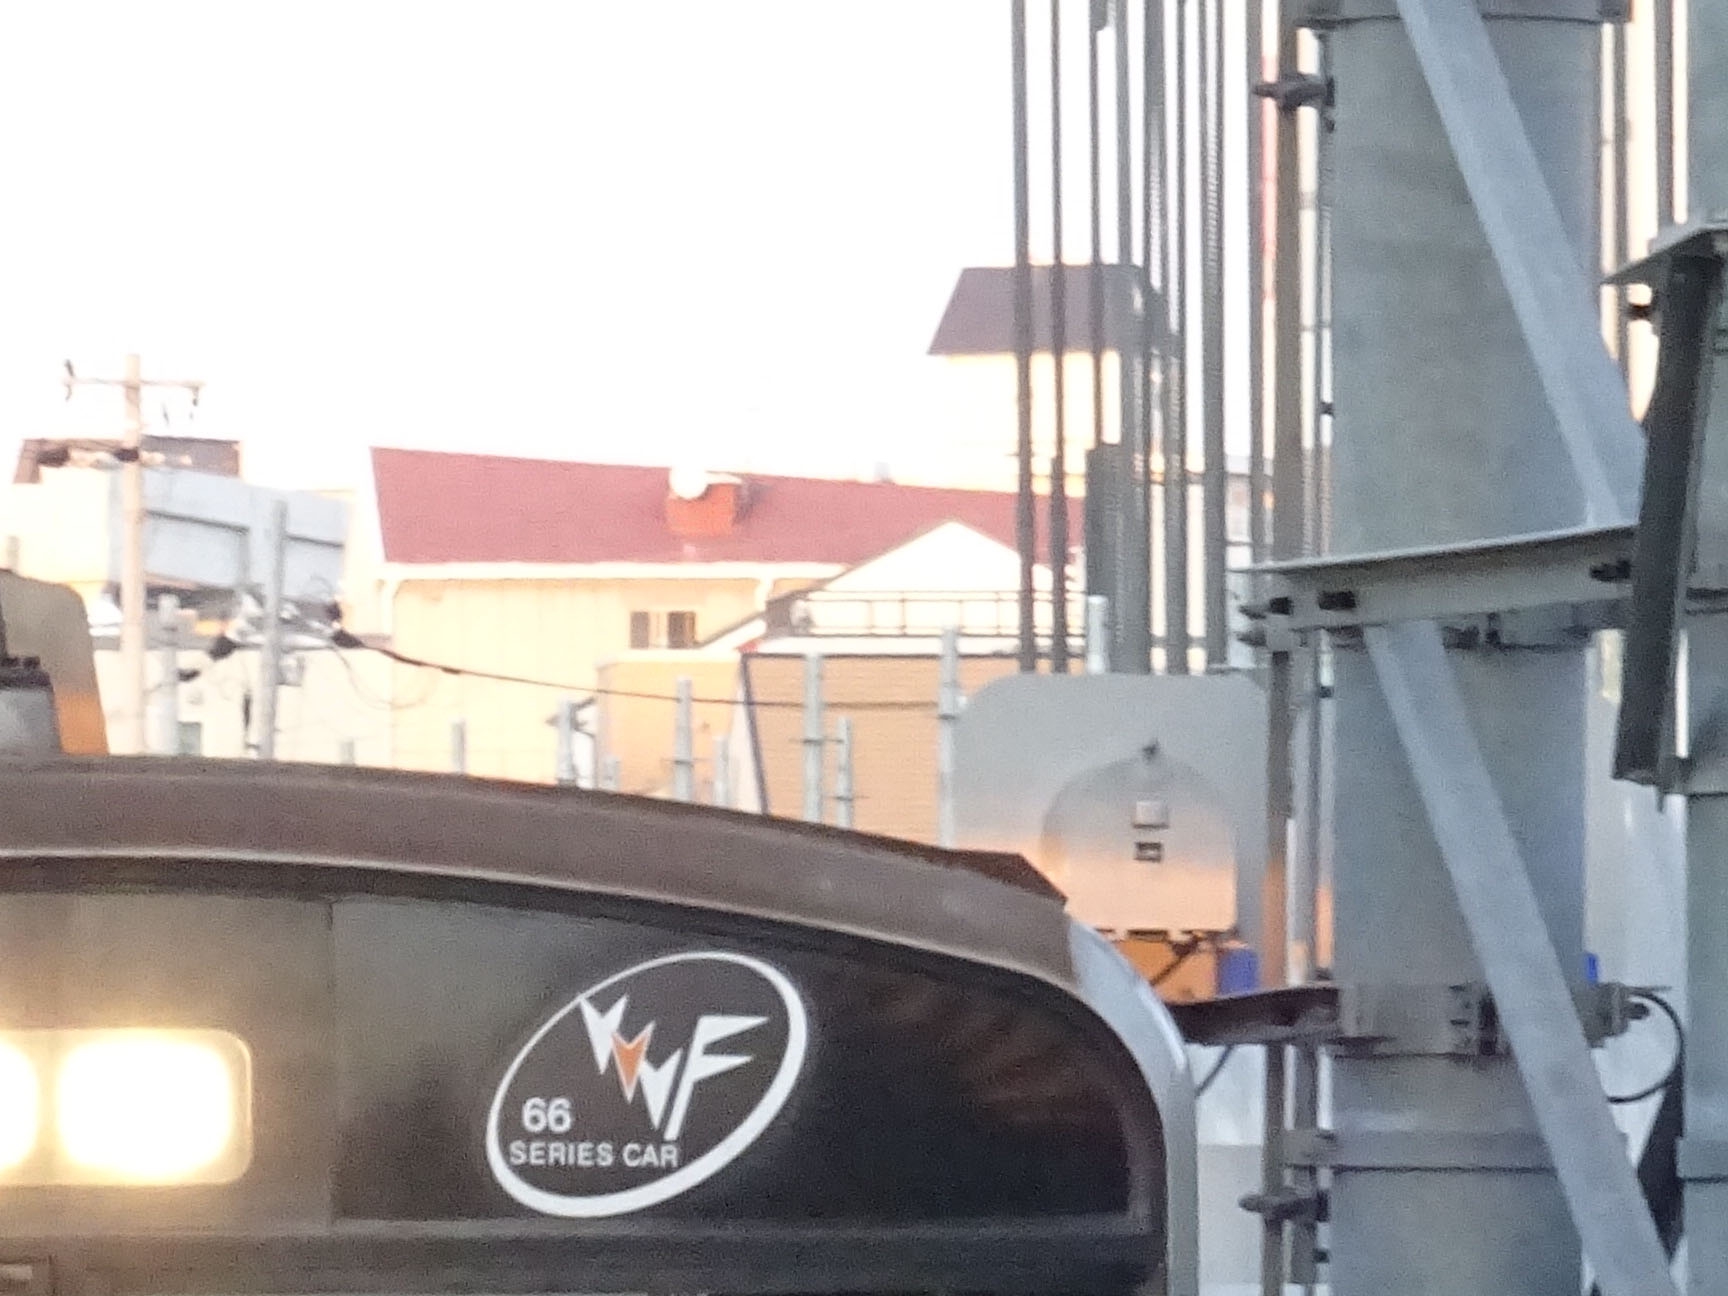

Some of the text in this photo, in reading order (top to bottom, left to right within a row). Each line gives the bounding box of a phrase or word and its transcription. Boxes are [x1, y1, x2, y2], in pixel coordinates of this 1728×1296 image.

[521, 1097, 573, 1133] 66
[508, 1140, 680, 1168] SERIES CAR
